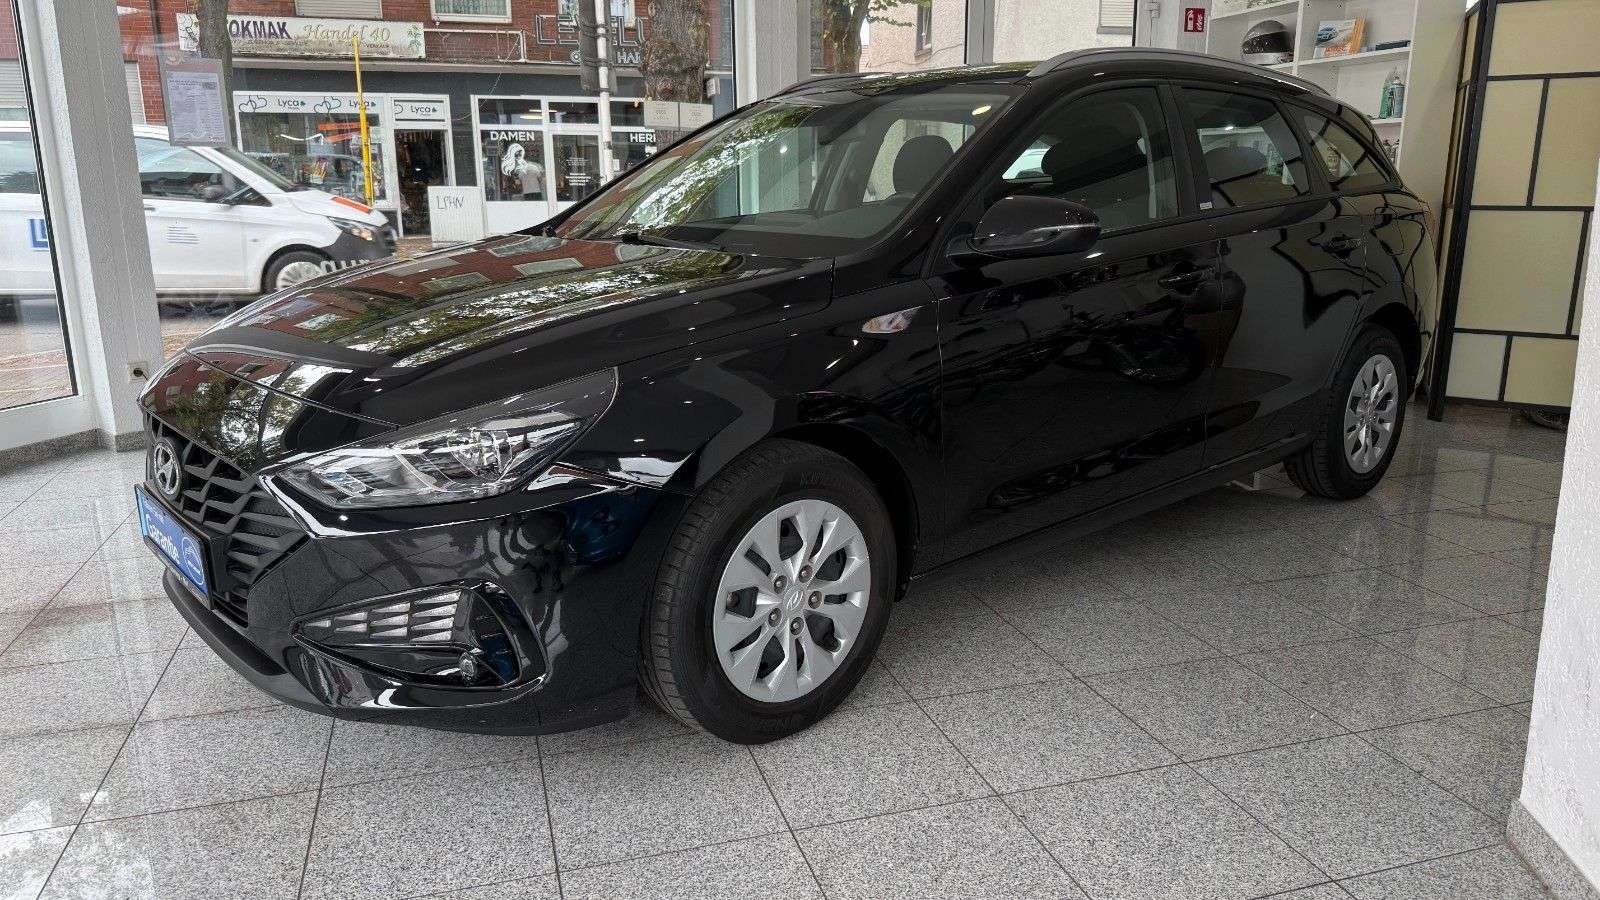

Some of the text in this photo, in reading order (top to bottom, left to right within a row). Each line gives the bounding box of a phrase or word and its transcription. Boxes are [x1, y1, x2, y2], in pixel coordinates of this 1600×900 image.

[304, 24, 368, 40] Handel
[370, 27, 391, 41] 40
[277, 98, 299, 107] Lyca
[349, 99, 370, 108] Lya
[410, 105, 431, 114] Lyca
[490, 131, 536, 141] DAMEN
